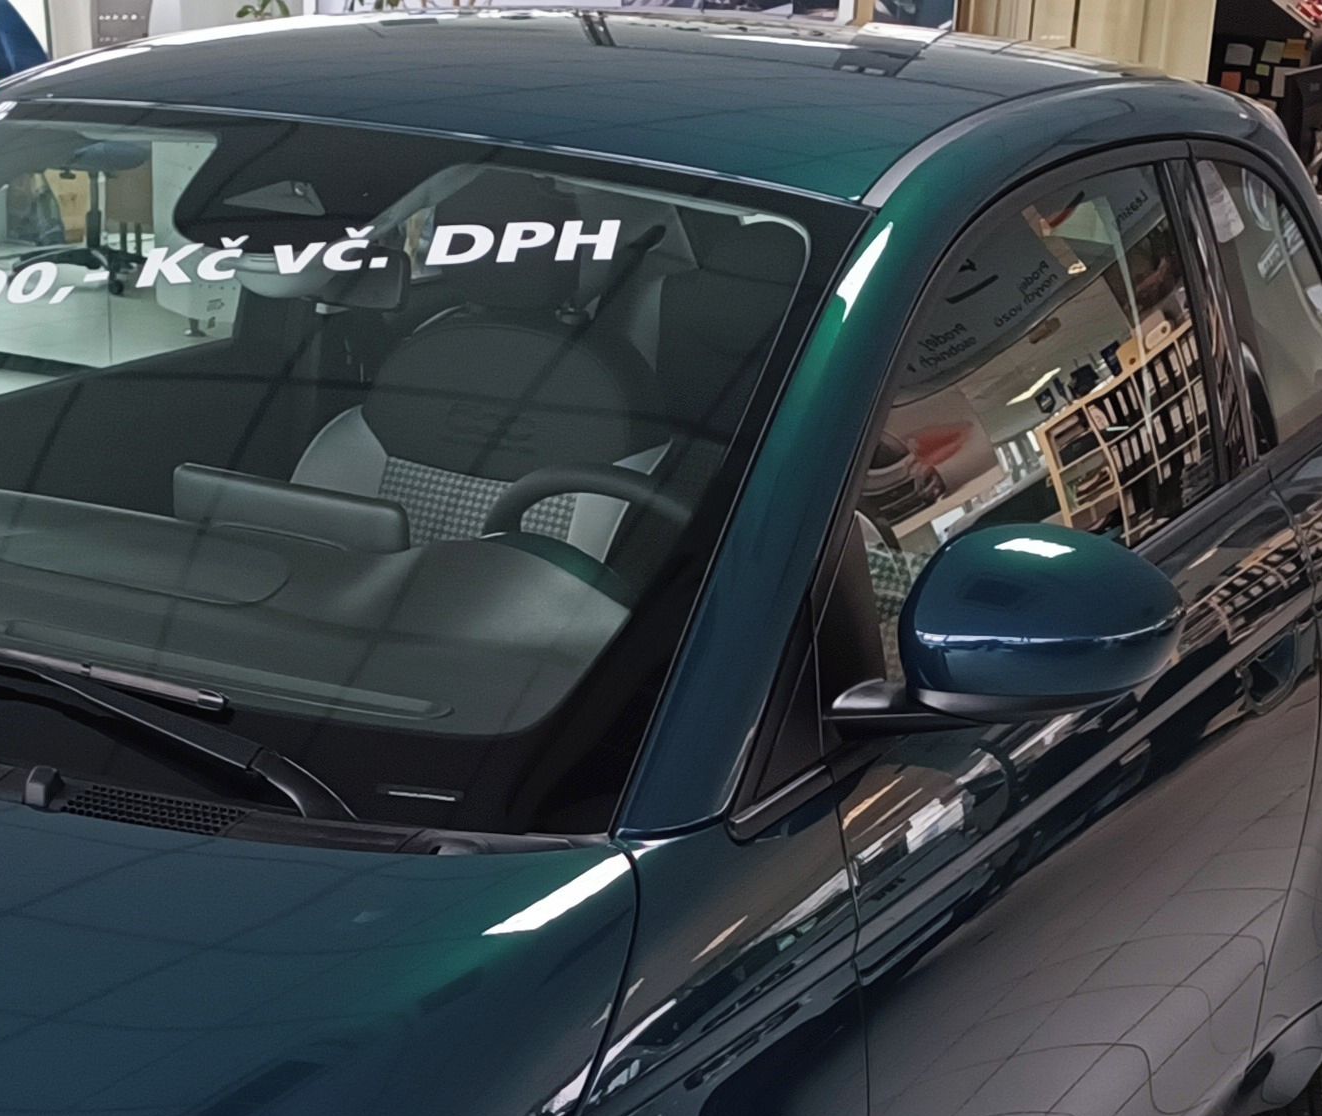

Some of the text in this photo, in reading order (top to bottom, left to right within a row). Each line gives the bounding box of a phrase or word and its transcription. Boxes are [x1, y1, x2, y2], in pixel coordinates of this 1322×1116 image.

[136, 235, 249, 288] Kč
[274, 226, 389, 274] vč.
[425, 220, 621, 266] DPH
